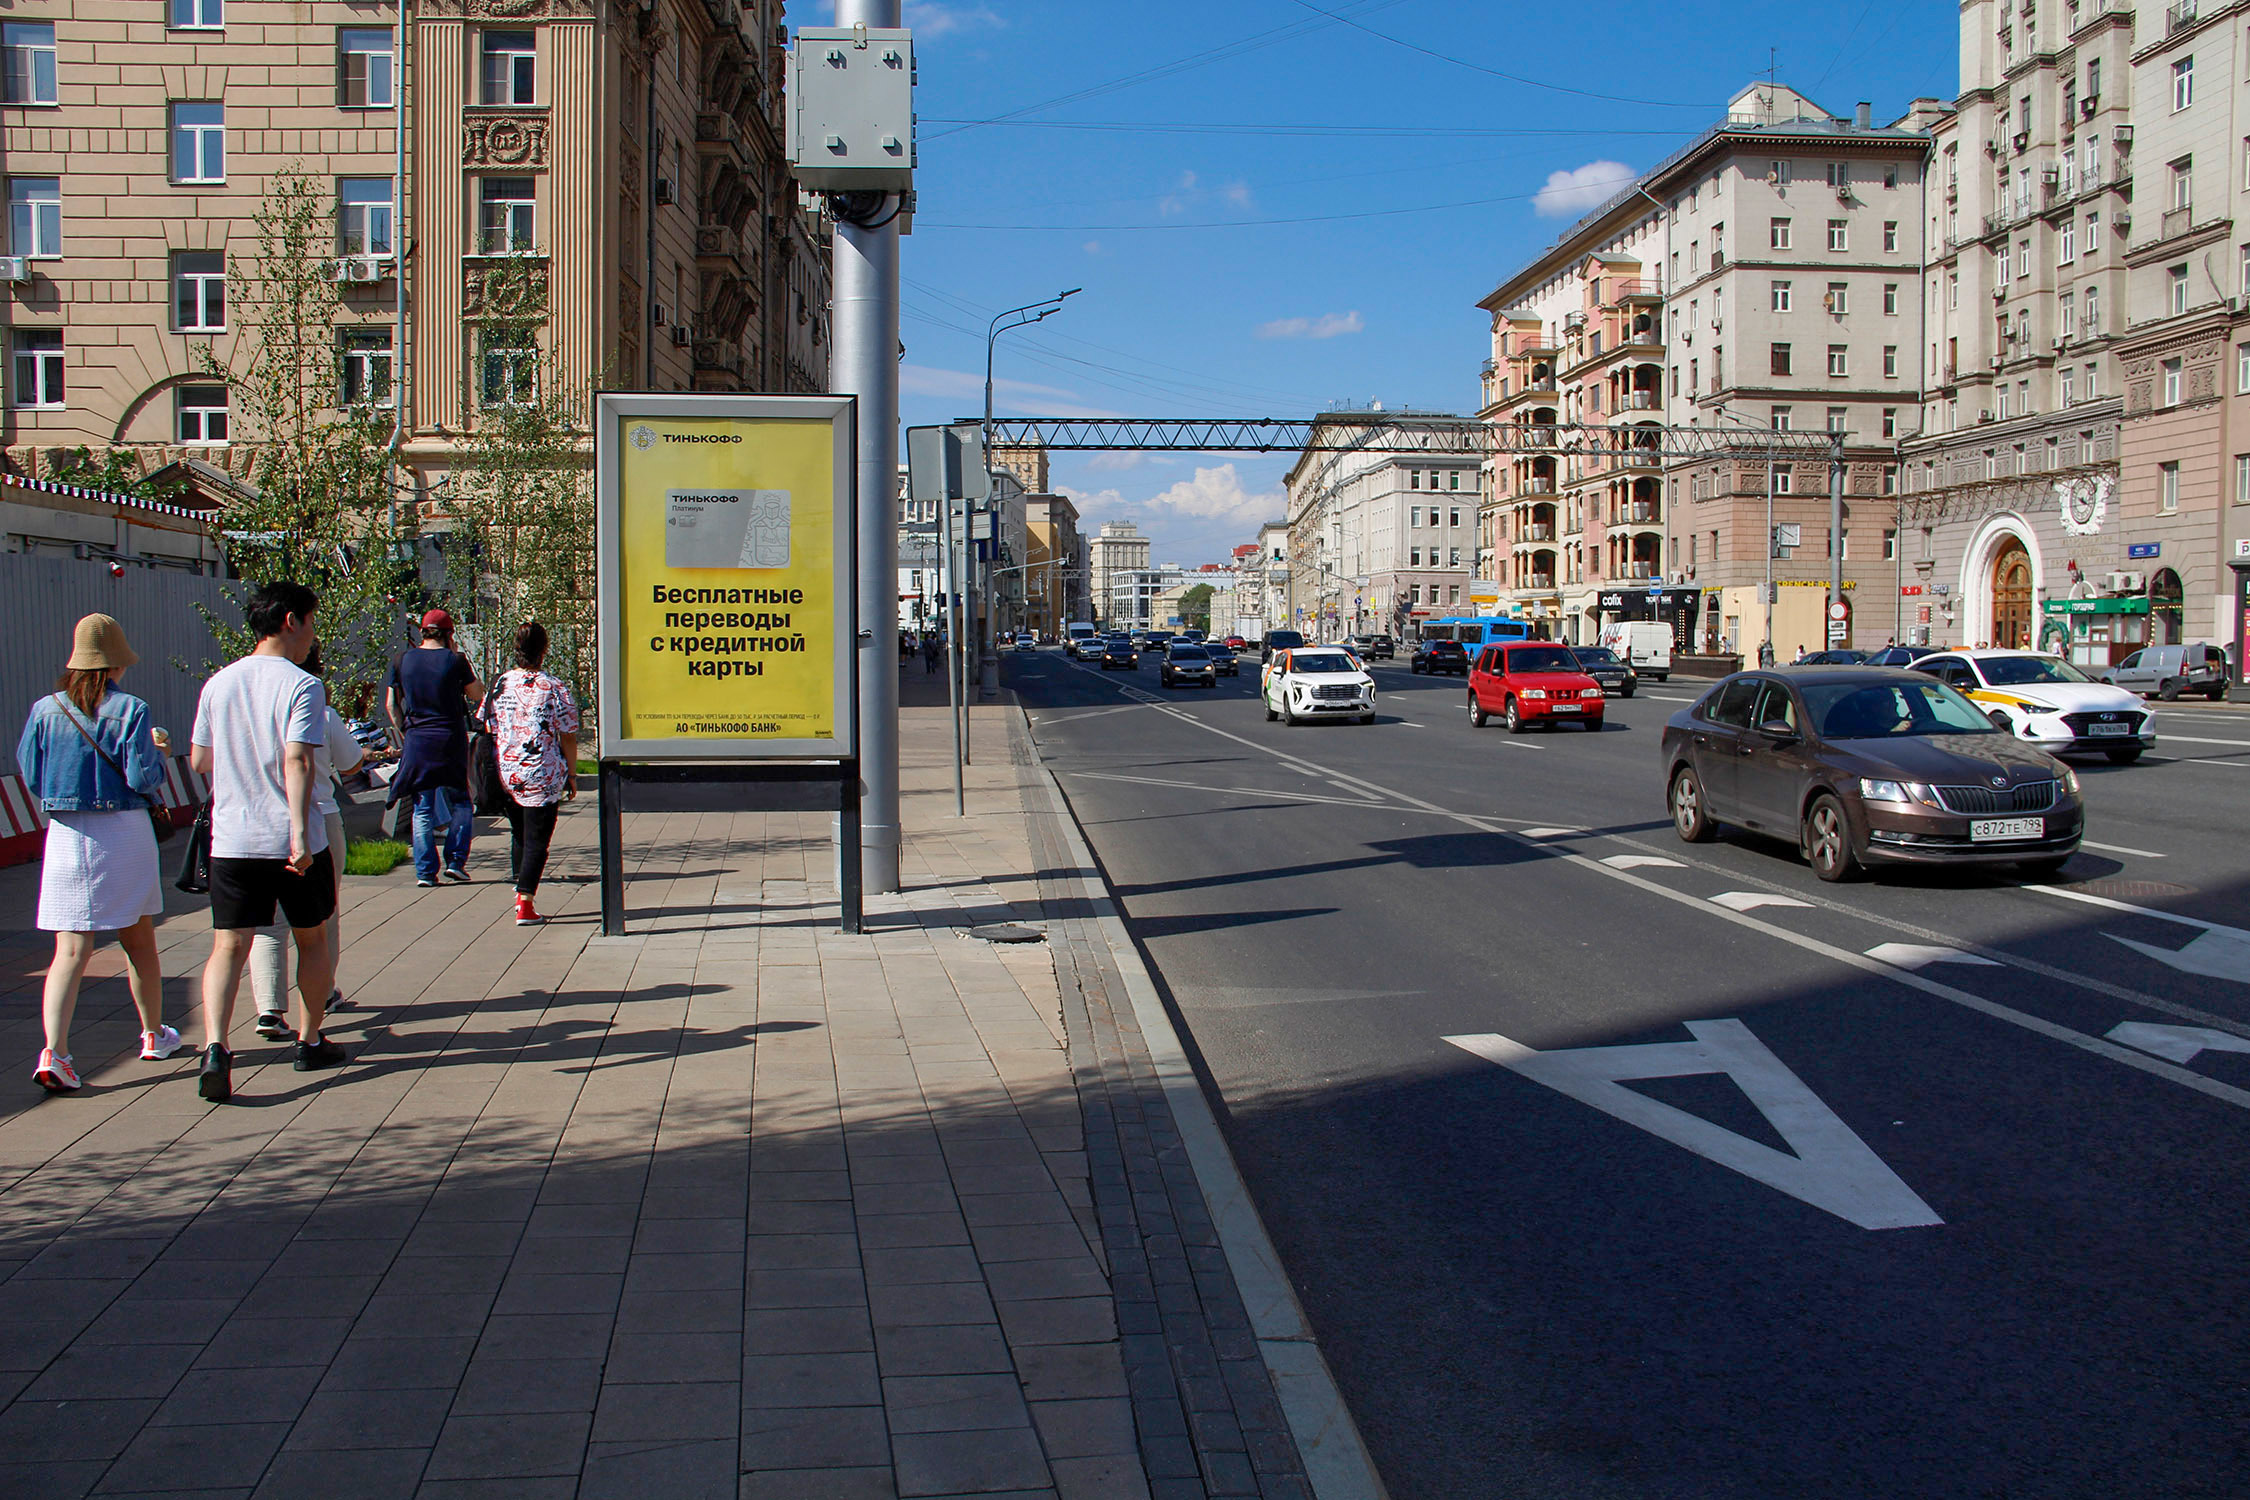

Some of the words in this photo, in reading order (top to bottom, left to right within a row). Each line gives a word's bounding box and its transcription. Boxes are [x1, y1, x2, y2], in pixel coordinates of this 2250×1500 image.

[662, 434, 743, 444] ТИНЬКОФФ
[671, 495, 740, 503] ТИНЬКОФФ
[671, 504, 705, 513] Платинум
[1817, 580, 1857, 591] BAERY
[652, 584, 804, 605] Бесплатные
[1602, 593, 1623, 606] cofix
[665, 612, 791, 633] переводы
[650, 635, 665, 652] с
[670, 632, 806, 656] кредитной
[688, 660, 764, 681] карты
[676, 722, 688, 732] АО
[690, 722, 749, 733] «ТИНЬКОФФ
[751, 722, 782, 733] БАНК»
